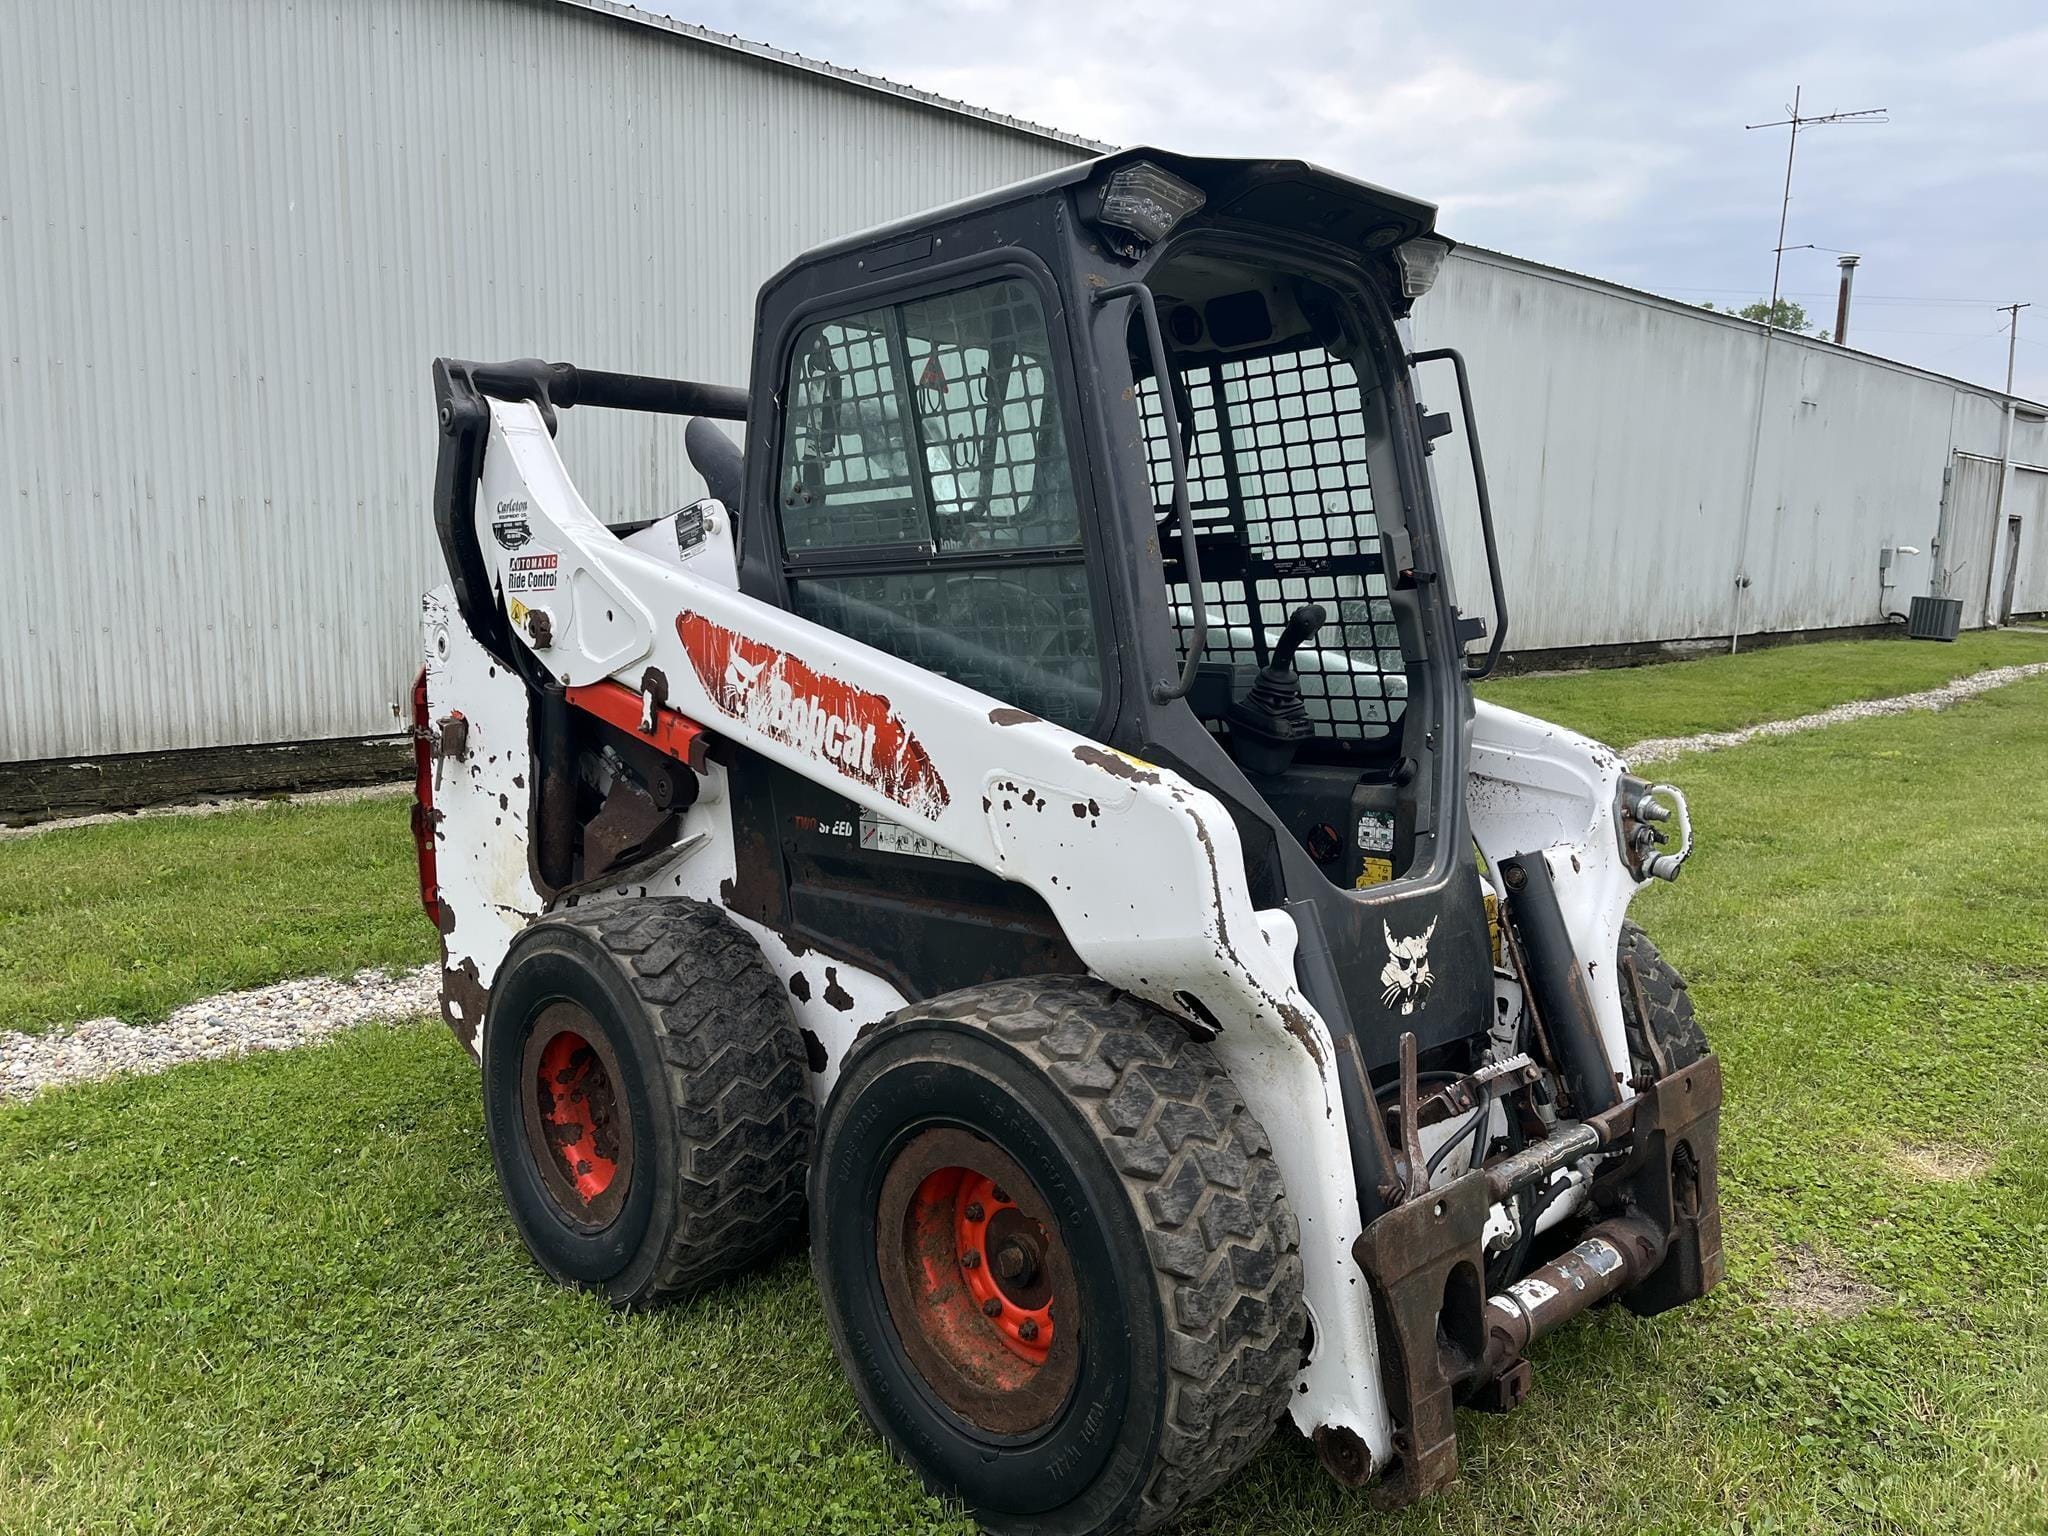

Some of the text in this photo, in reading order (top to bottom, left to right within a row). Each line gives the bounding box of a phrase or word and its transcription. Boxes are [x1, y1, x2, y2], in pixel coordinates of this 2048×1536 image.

[497, 499, 528, 513] Carleton
[510, 555, 557, 570] AUTOMATIC
[508, 570, 558, 589] Ride Control
[770, 677, 877, 776] Bobcat
[793, 815, 817, 831] TWO
